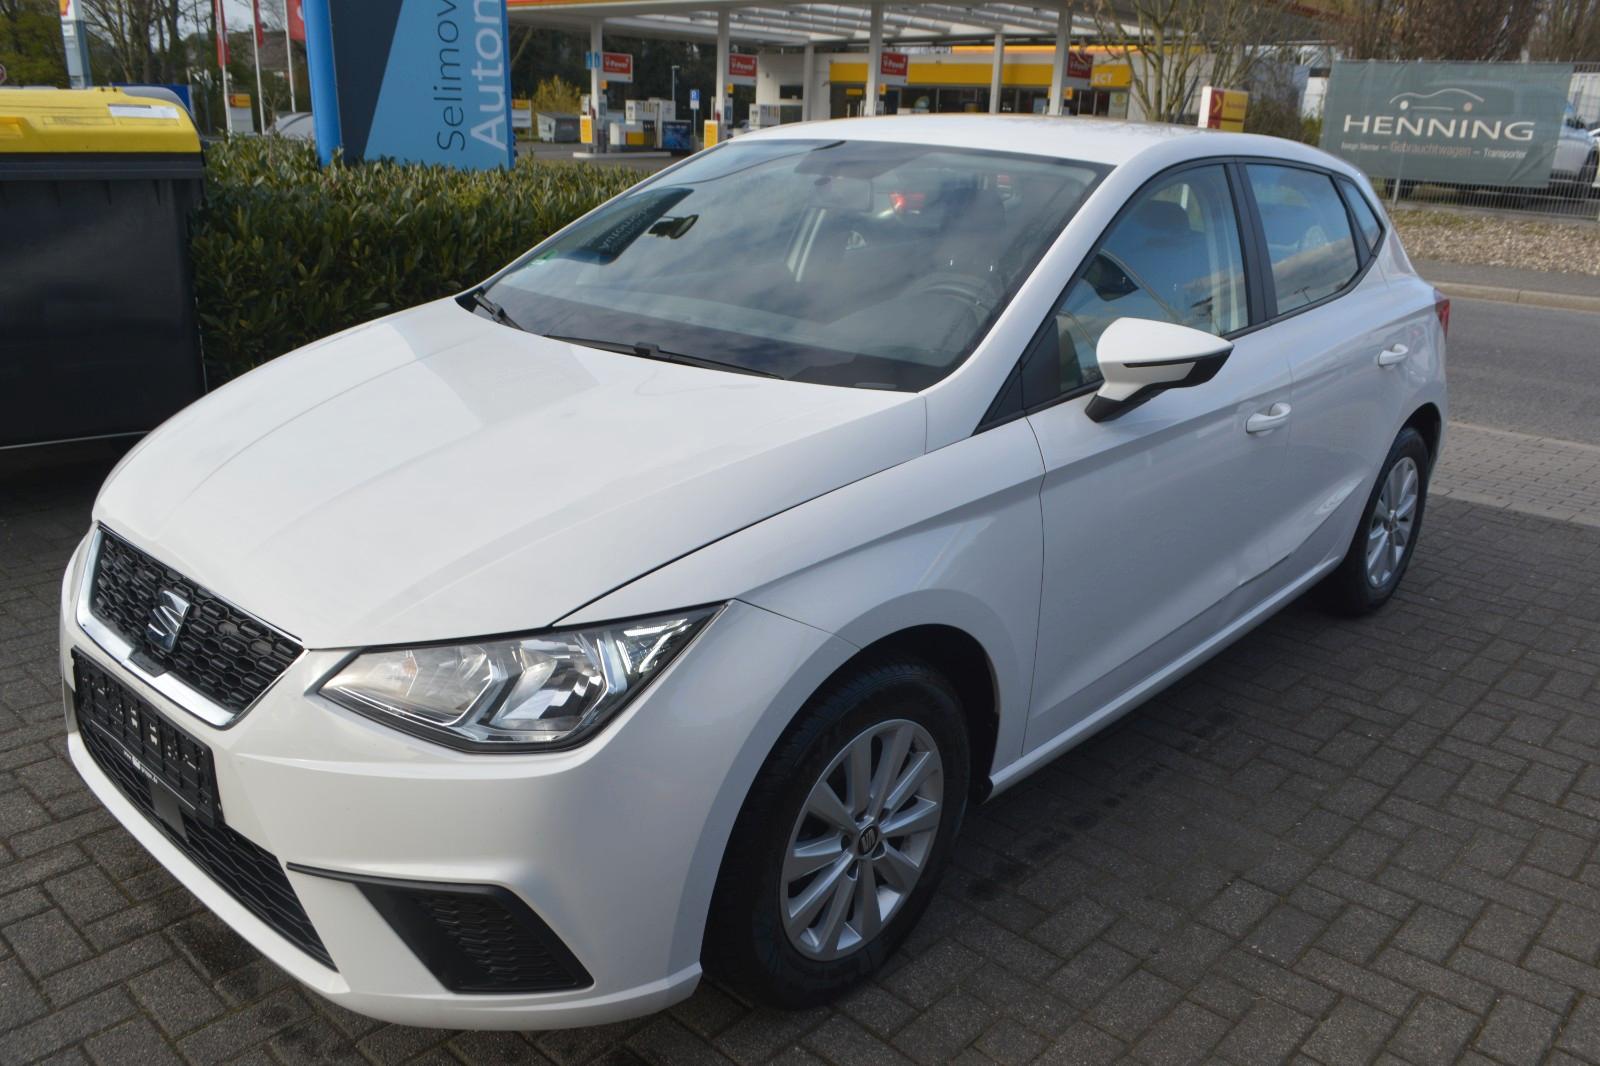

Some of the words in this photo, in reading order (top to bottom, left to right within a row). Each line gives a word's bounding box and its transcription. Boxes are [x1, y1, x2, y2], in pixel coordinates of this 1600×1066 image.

[1343, 114, 1536, 141] HENNING
[1390, 141, 1471, 157] Gebrauchtwagen
[1484, 147, 1527, 160] Transporter
